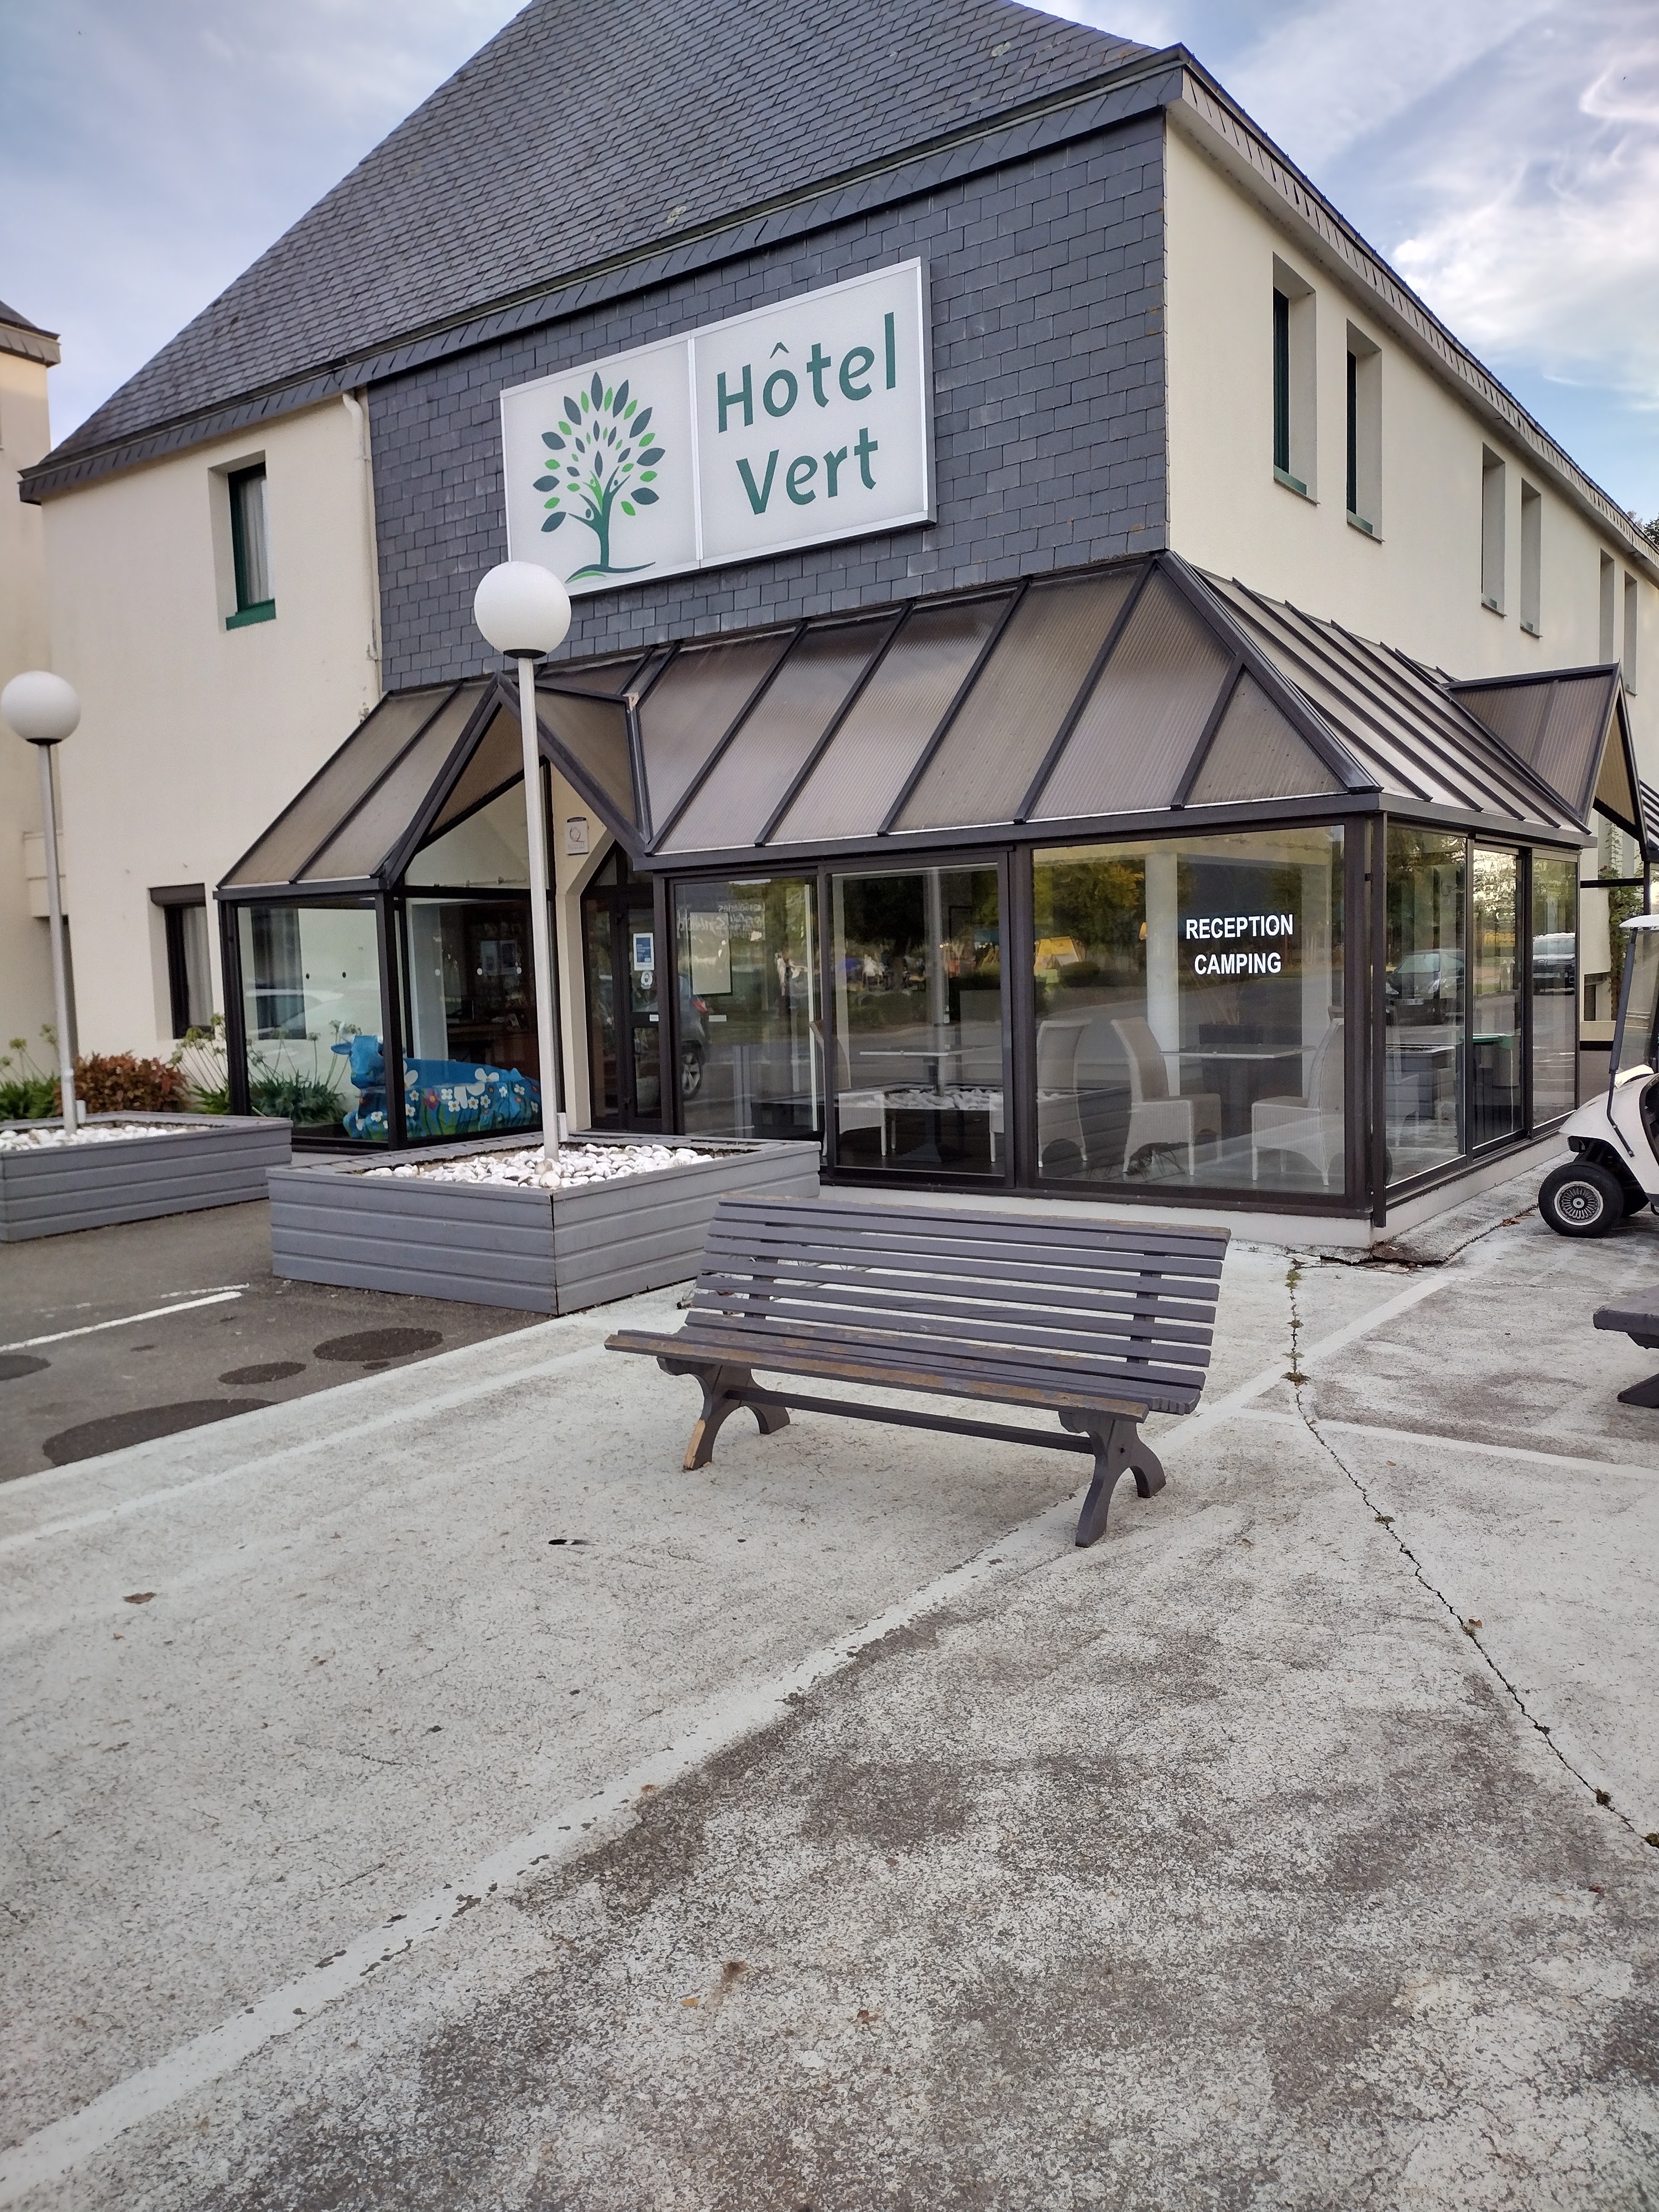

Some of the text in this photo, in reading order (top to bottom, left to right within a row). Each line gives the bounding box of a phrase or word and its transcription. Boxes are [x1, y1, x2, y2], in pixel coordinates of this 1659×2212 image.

[717, 312, 896, 433] Hôtel
[736, 427, 878, 515] Vert
[1186, 914, 1293, 939] RECEPTION
[1194, 952, 1281, 974] CAMPING
